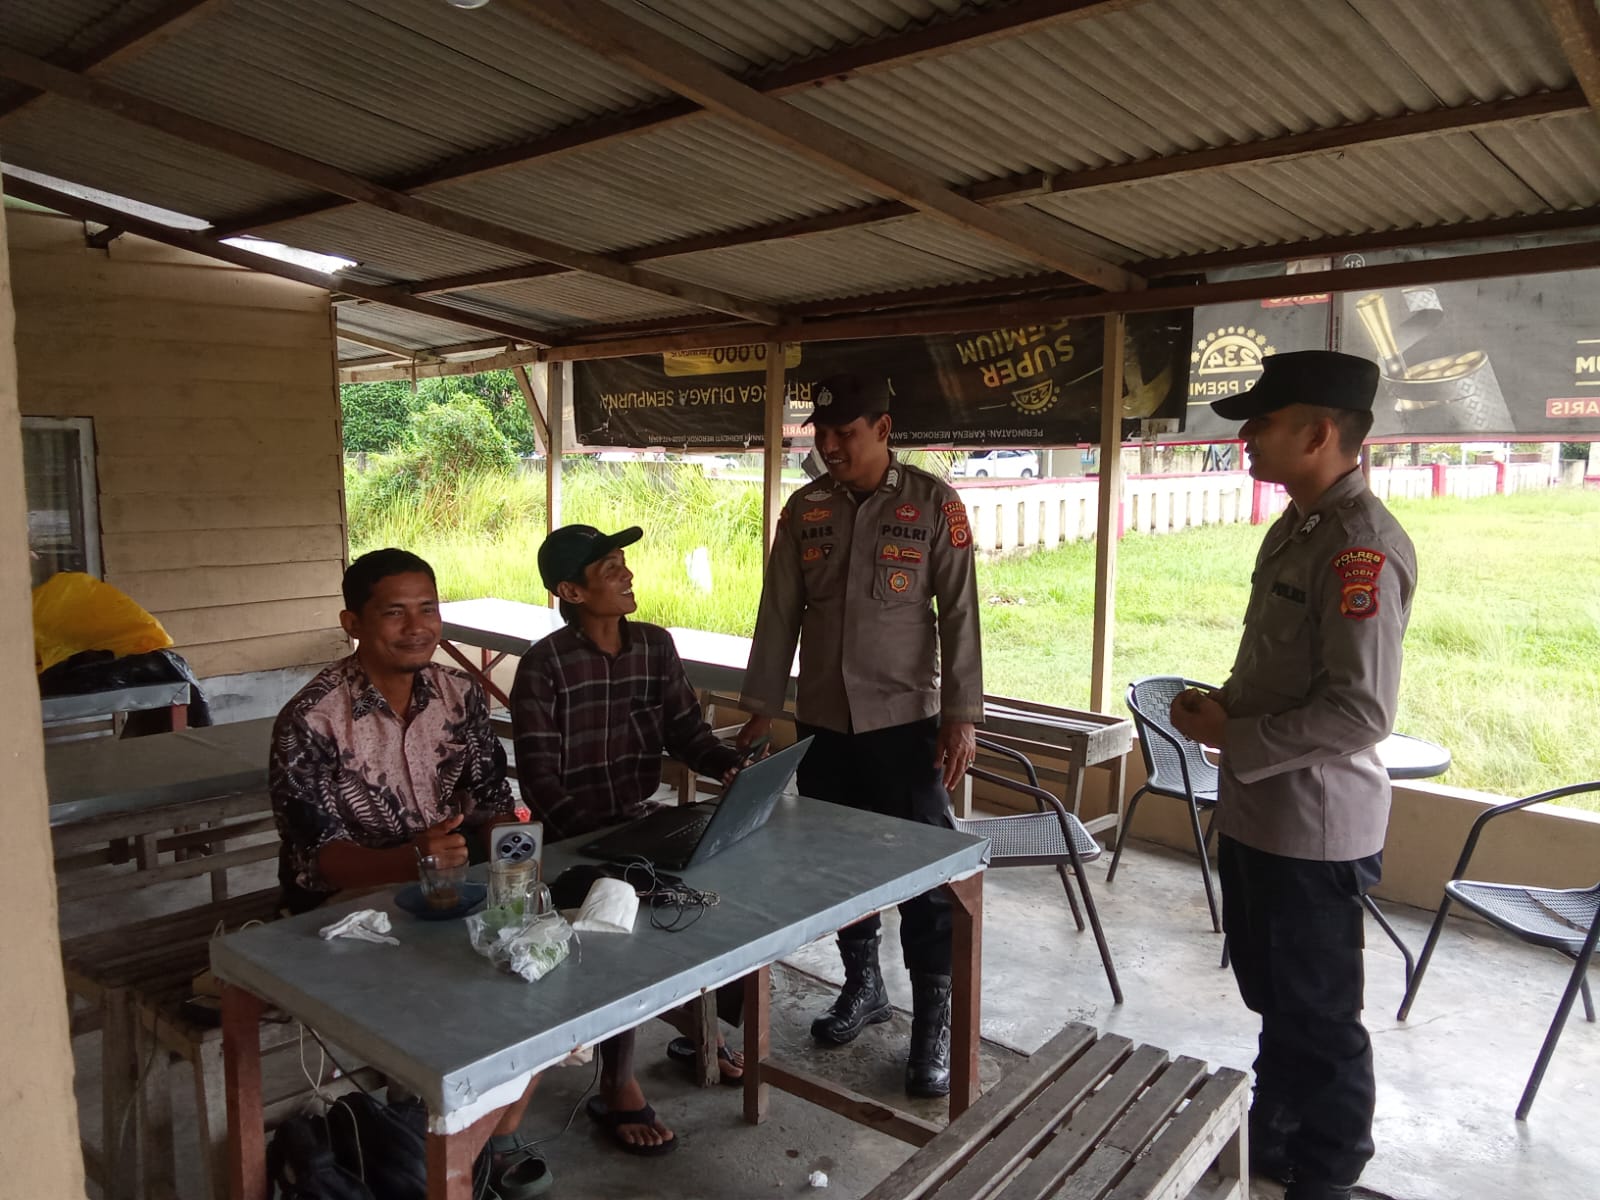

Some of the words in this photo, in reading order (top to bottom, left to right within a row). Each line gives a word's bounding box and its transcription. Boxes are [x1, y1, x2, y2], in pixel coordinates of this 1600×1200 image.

[979, 334, 1075, 389] SUPER
[677, 386, 735, 406] DIJAGA
[952, 429, 985, 439] KARENA
[801, 525, 833, 540] ARIS
[881, 524, 927, 541] POLRI
[1334, 551, 1381, 567] POLRES
[1344, 569, 1374, 578] ACEH
